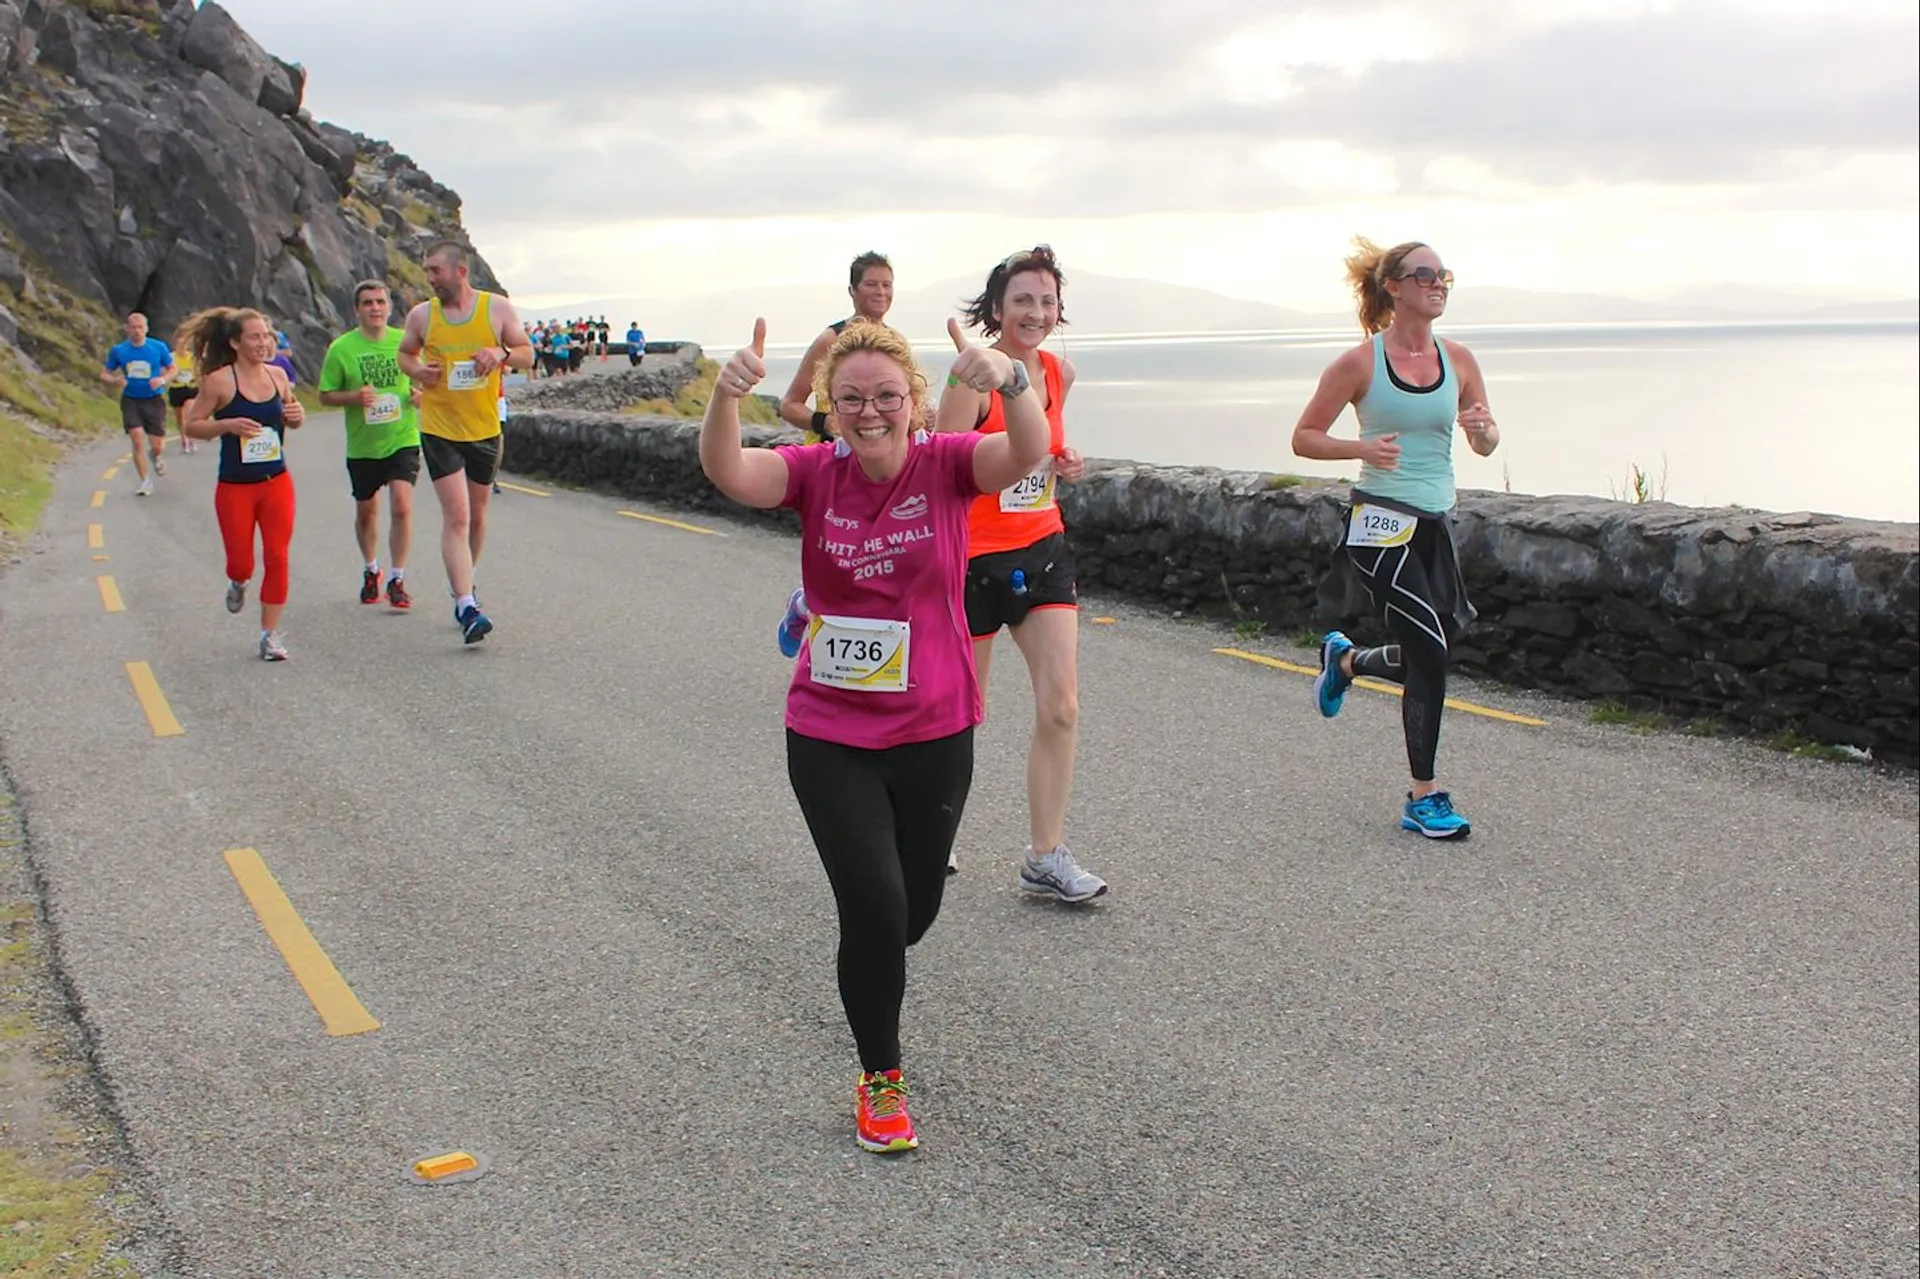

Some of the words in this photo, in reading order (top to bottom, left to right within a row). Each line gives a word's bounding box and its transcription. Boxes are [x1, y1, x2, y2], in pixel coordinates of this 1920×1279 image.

[371, 403, 395, 416] 2442
[1012, 475, 1045, 494] 2794
[1363, 515, 1399, 533] 1288
[824, 540, 857, 557] HIT
[887, 525, 935, 545] WALL
[853, 559, 895, 581] 2015
[826, 637, 883, 662] 1736
